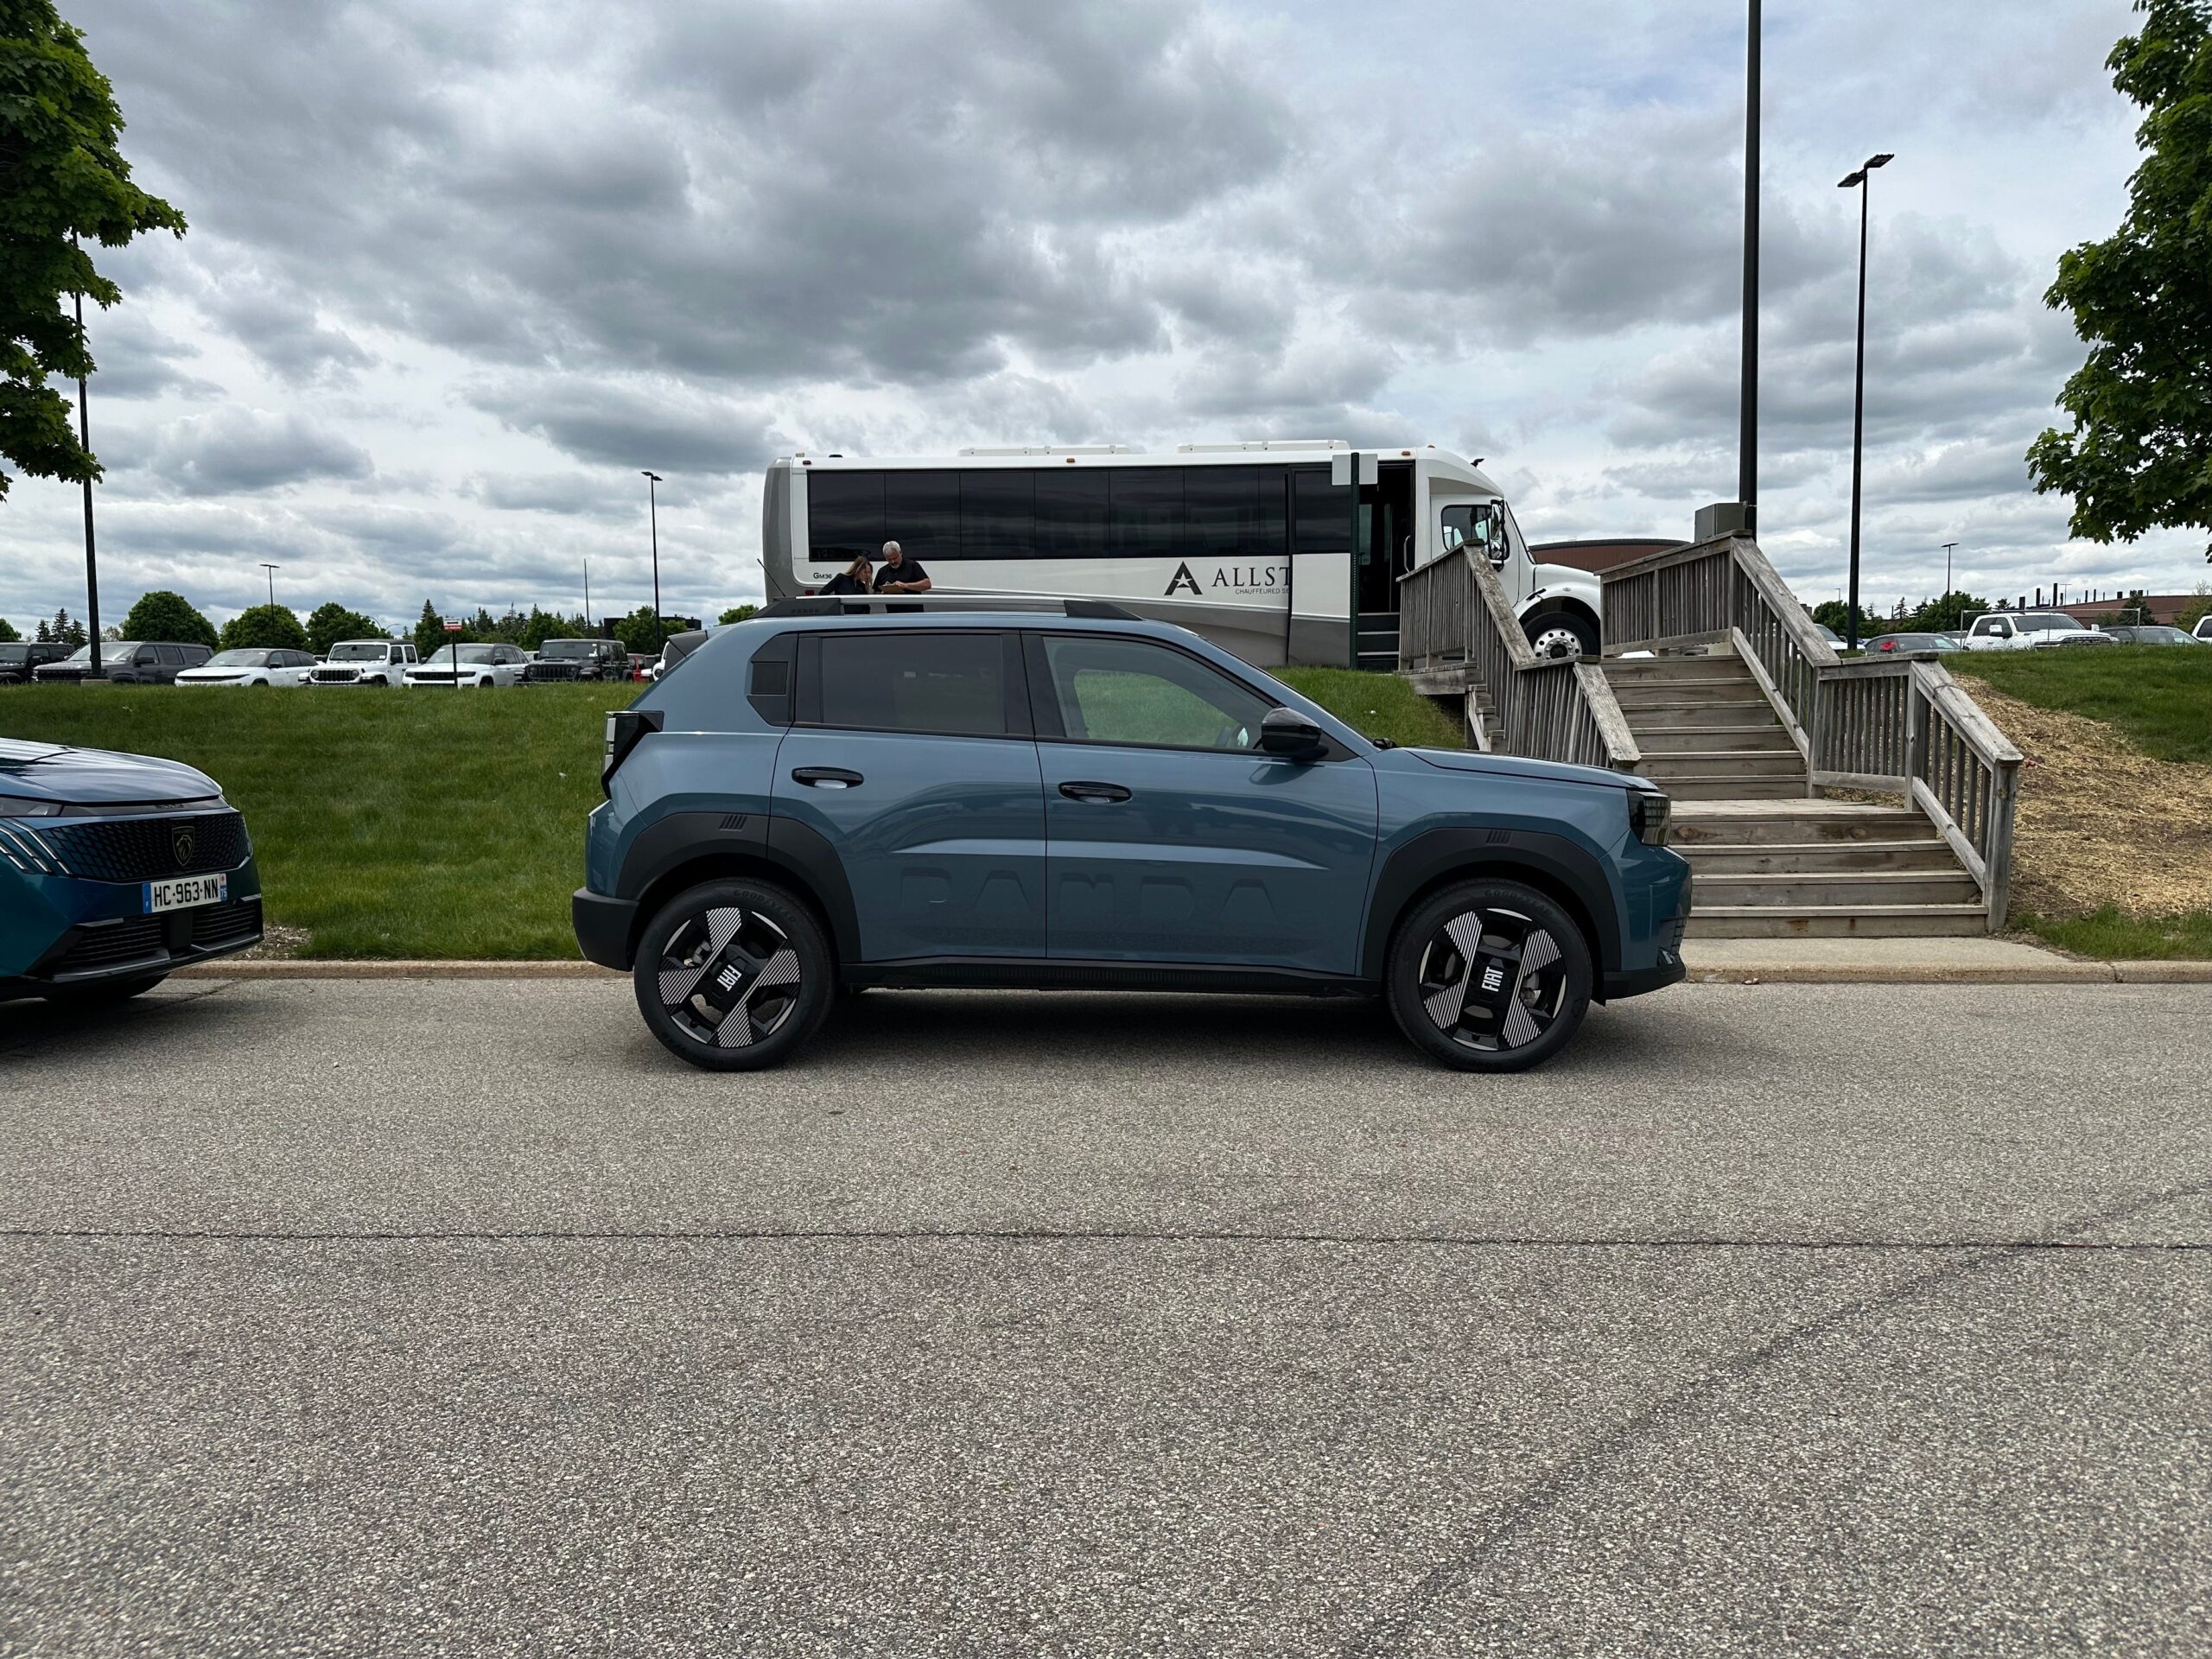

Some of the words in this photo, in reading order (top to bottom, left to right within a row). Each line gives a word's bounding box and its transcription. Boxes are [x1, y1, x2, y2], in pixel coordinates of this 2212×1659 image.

[154, 879, 219, 907] HC-963-NN
[716, 964, 742, 992] FIAT
[1481, 966, 1504, 992] FIAT
